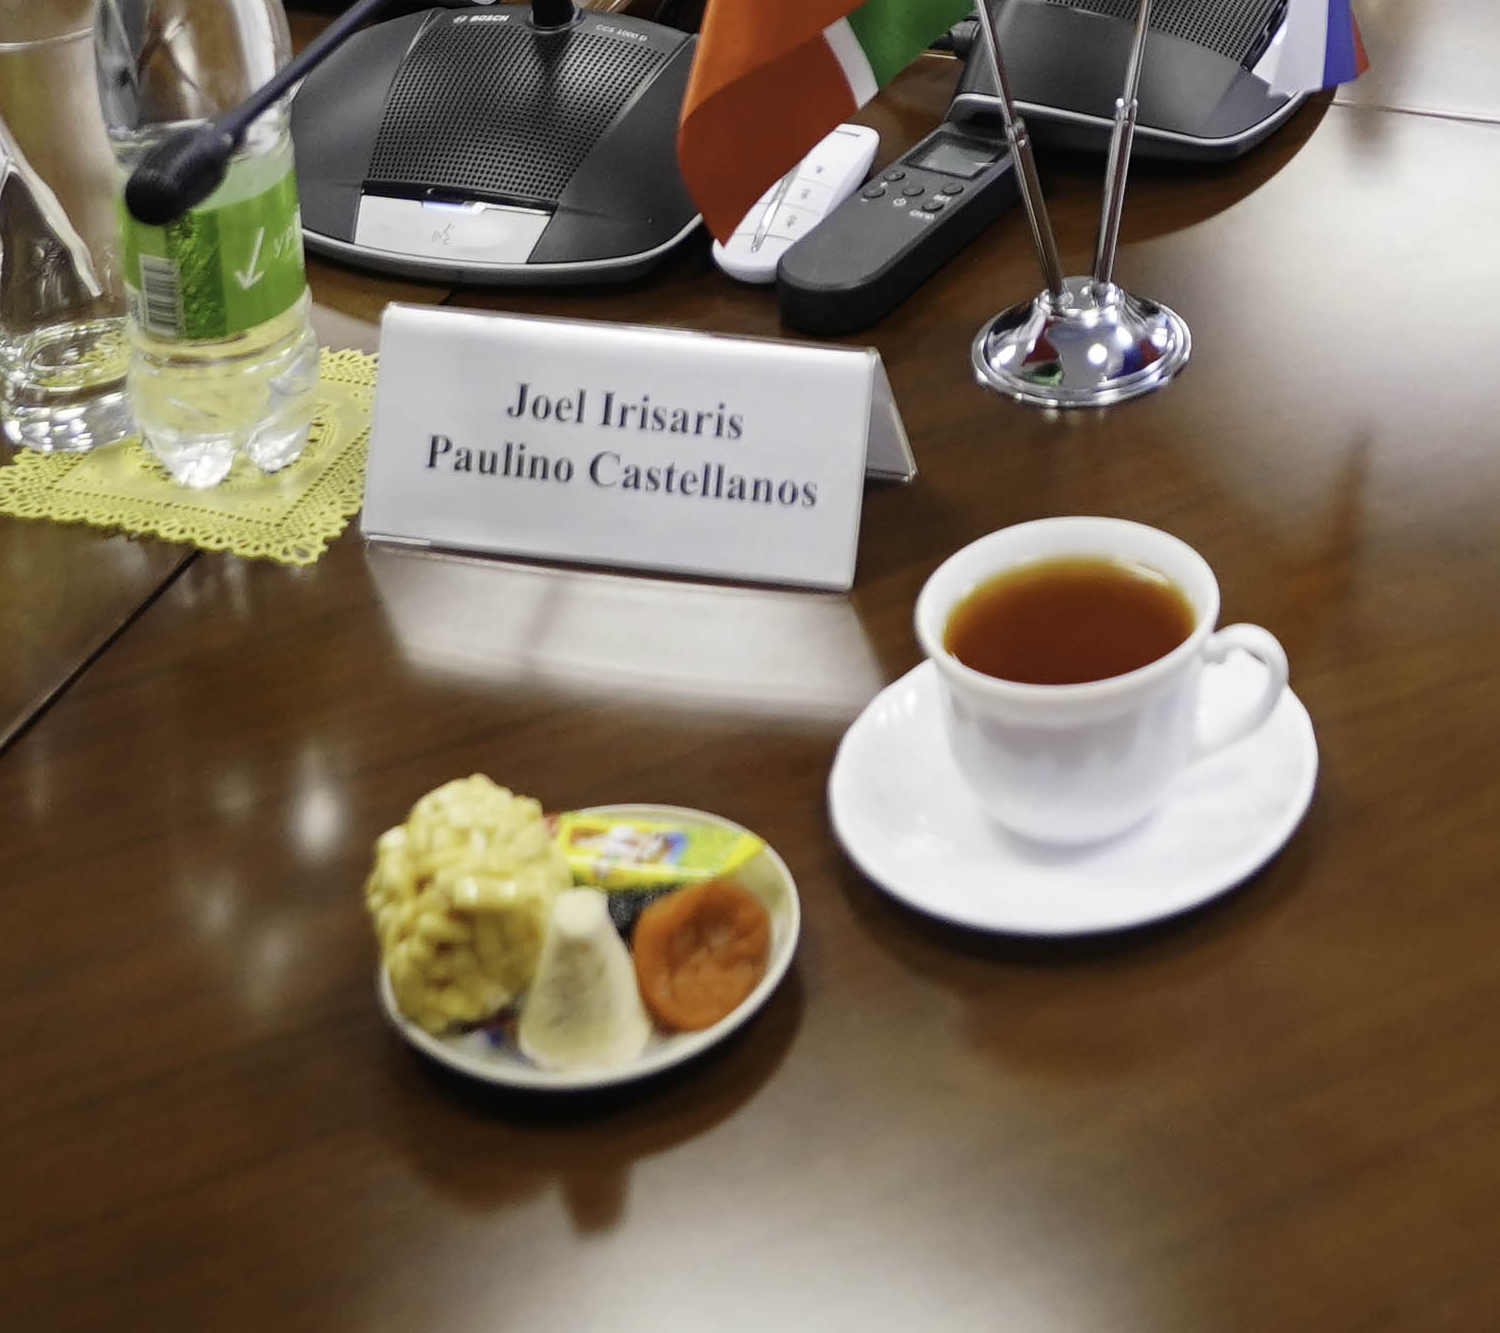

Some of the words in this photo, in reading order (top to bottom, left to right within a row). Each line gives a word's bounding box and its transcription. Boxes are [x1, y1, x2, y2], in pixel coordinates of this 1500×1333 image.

[469, 14, 510, 23] BOSCH
[507, 381, 587, 424] Joel
[598, 390, 745, 440] Irisaris
[426, 433, 575, 484] Paulino
[589, 450, 819, 509] Castellanos
